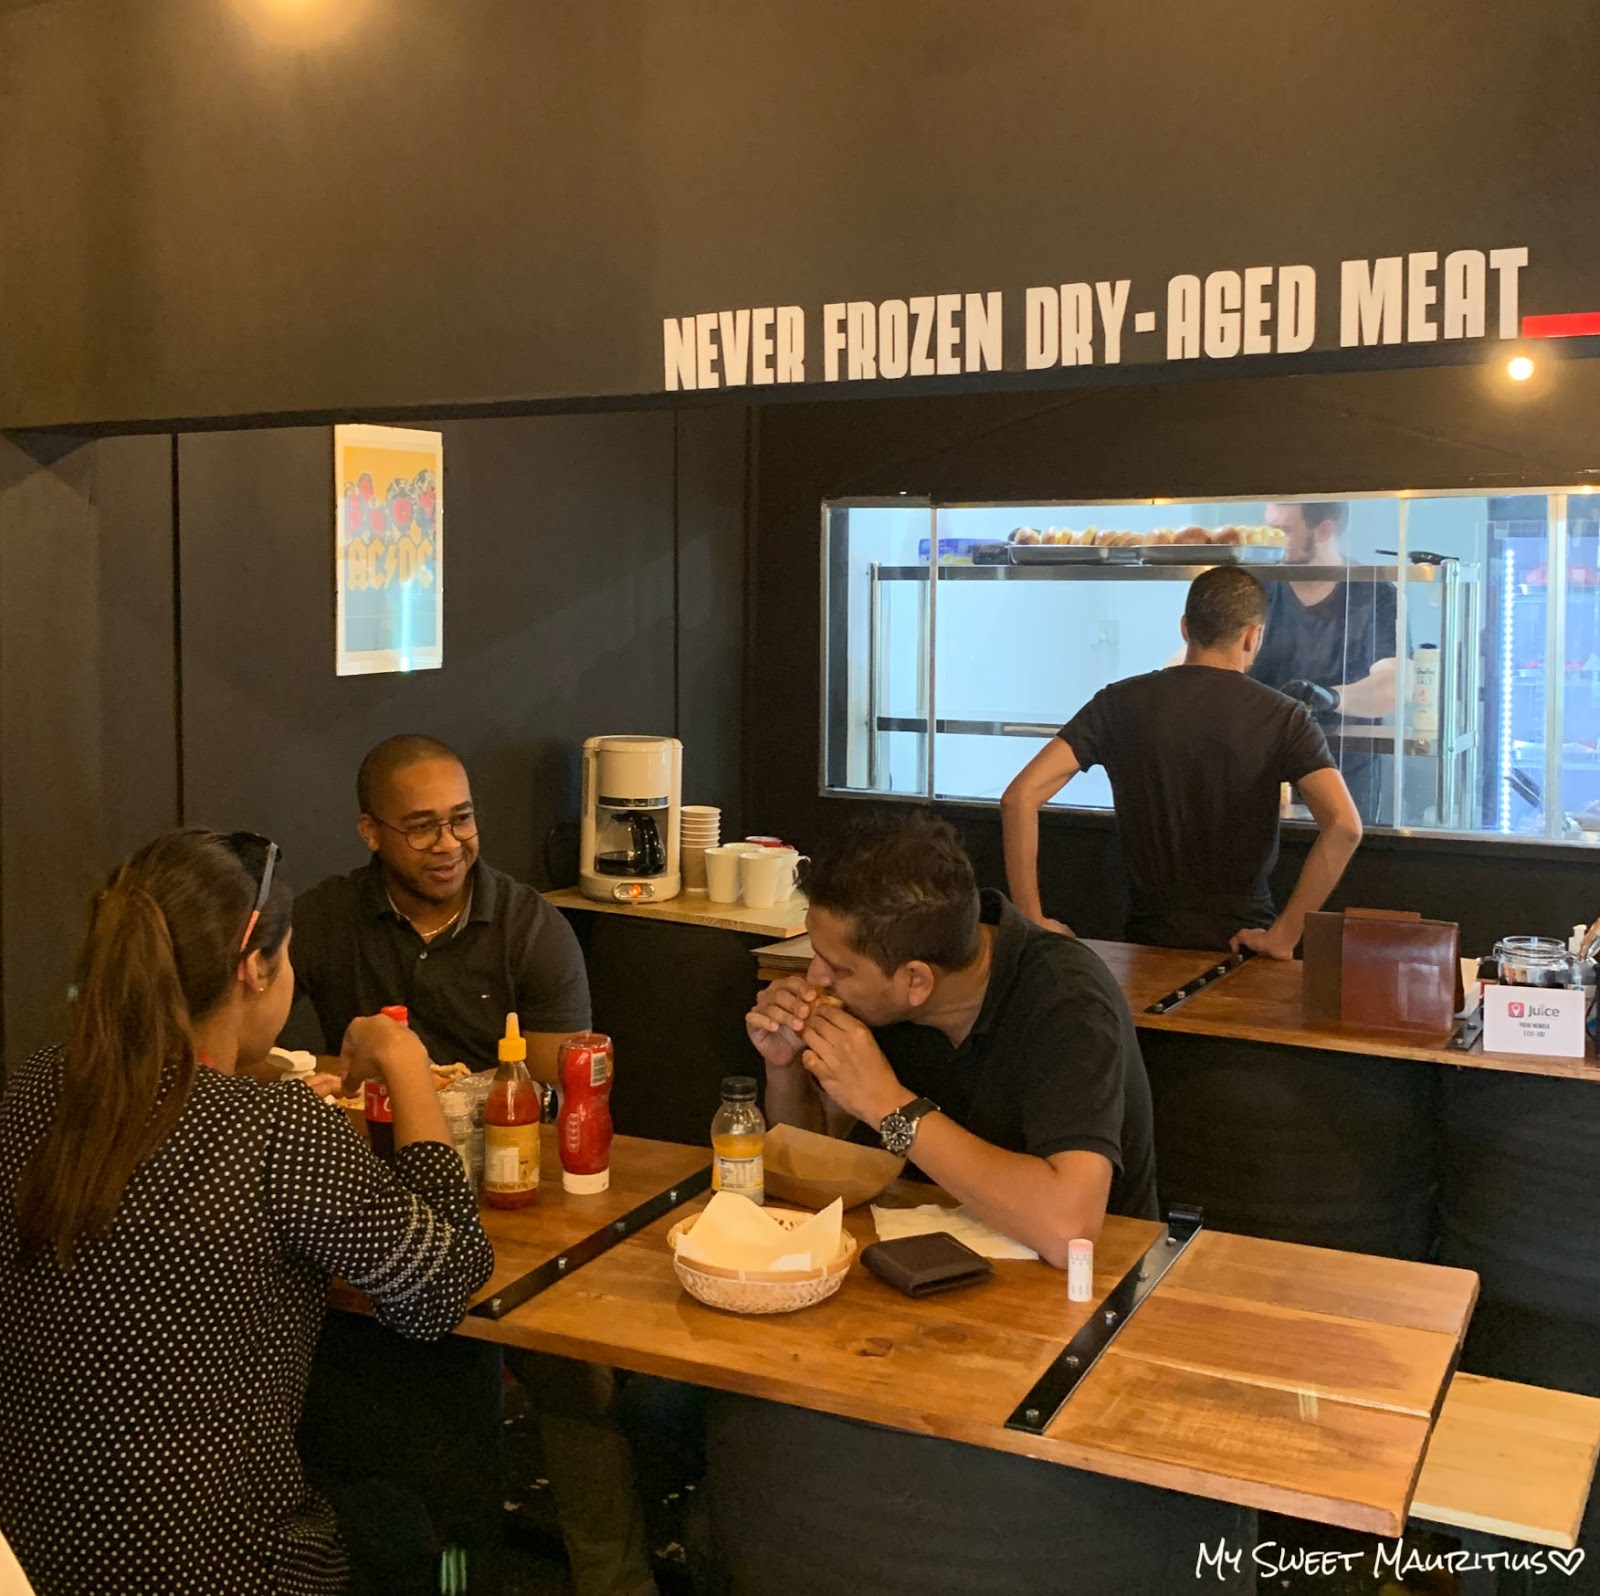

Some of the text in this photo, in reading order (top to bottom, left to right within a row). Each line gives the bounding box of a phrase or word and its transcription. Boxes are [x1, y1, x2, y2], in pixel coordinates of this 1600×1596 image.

[663, 305, 806, 392] NEVER
[823, 291, 1004, 382] FROZEN
[1339, 246, 1530, 348] MEAT
[1527, 1003, 1560, 1018] Juice
